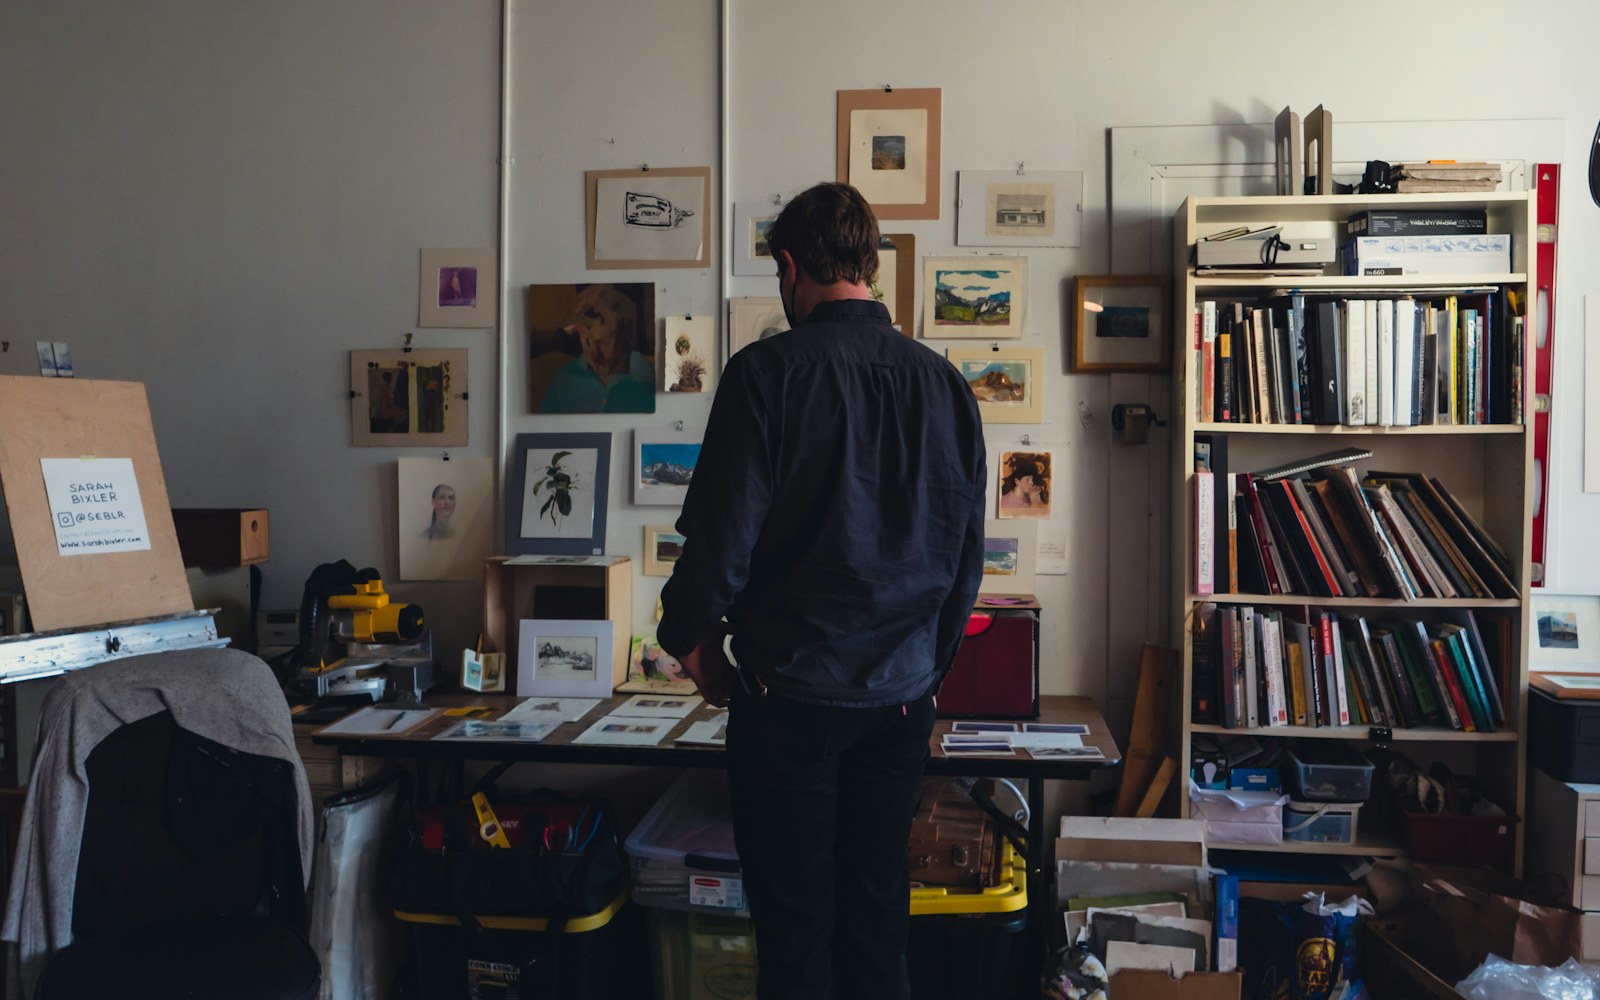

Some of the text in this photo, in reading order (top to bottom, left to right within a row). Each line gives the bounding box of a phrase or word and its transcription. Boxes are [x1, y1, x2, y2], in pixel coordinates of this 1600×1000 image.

[69, 482, 113, 493] SARAH
[71, 491, 118, 504] BIXLER
[75, 510, 126, 523] @SEBLR
